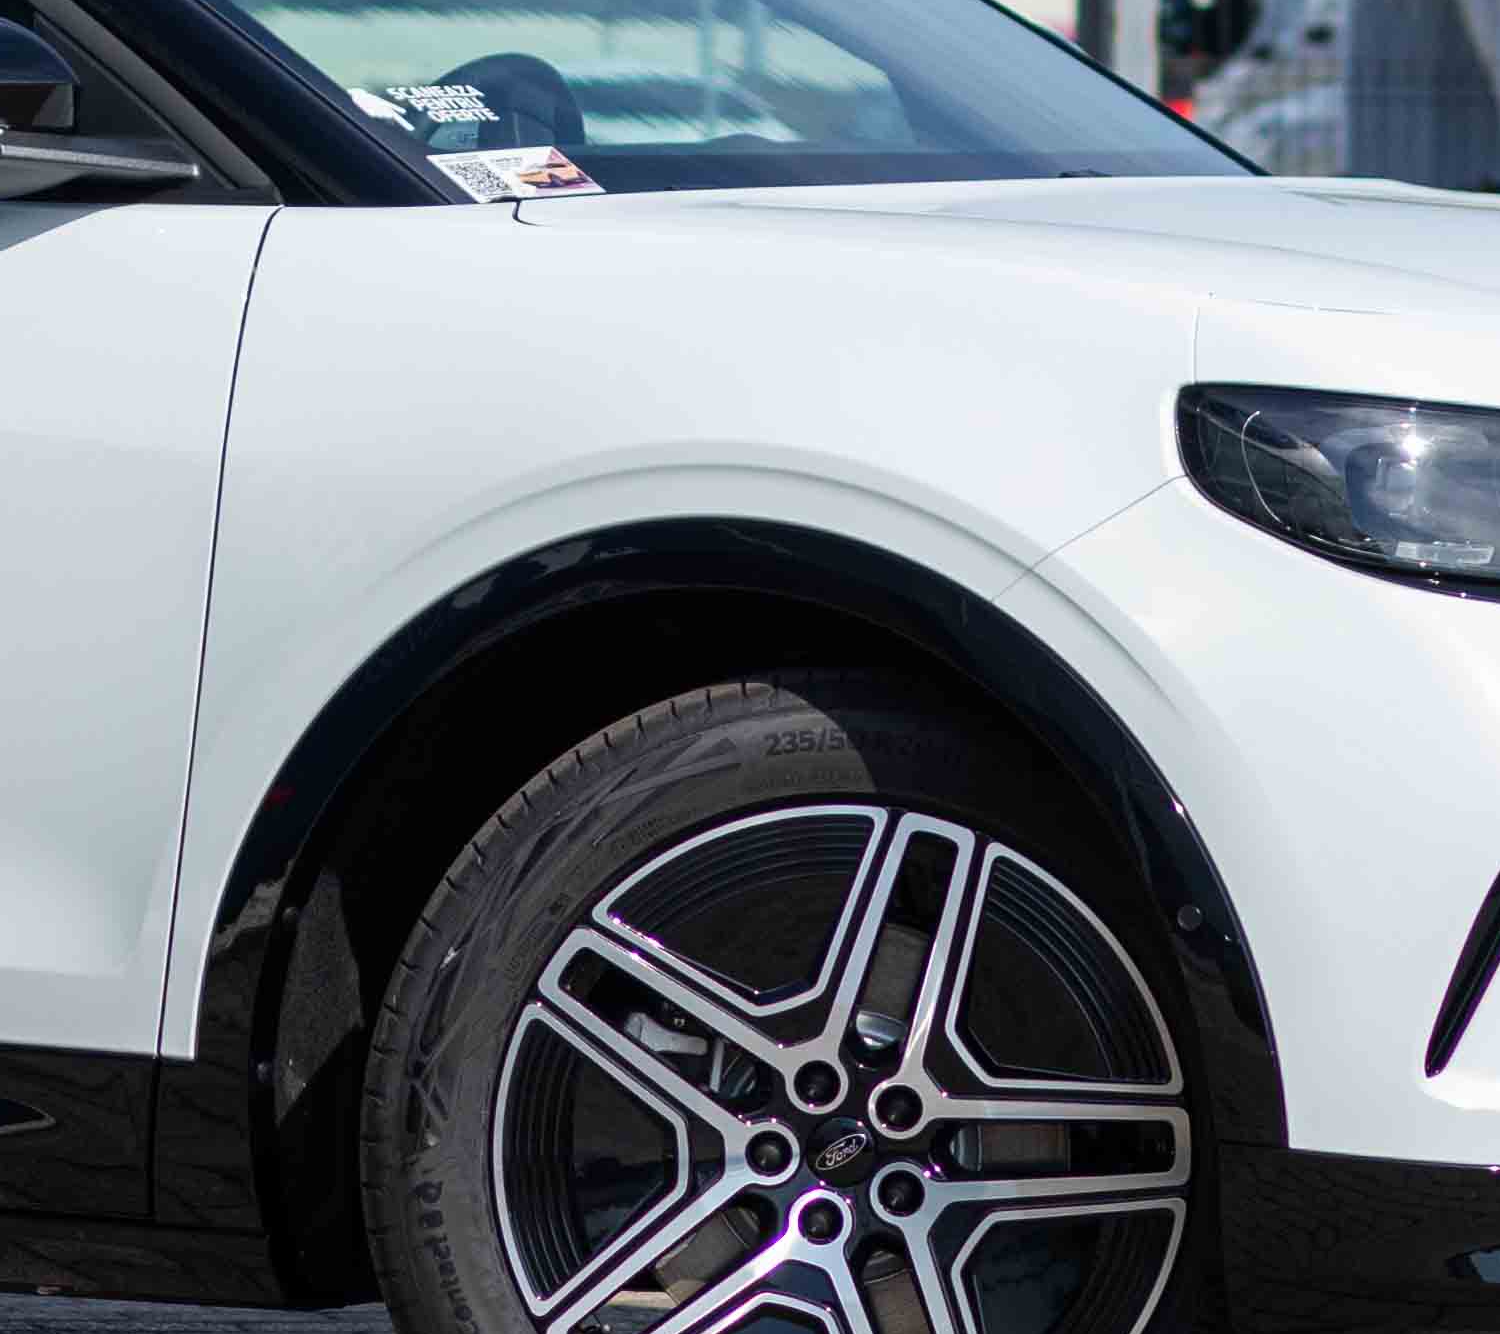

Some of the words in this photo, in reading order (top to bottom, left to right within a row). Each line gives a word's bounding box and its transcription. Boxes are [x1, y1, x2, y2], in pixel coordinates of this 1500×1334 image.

[386, 84, 485, 101] SCANEAZA
[408, 97, 484, 112] PENTRU
[426, 107, 500, 123] OFERTE
[824, 1138, 859, 1166] Ford
